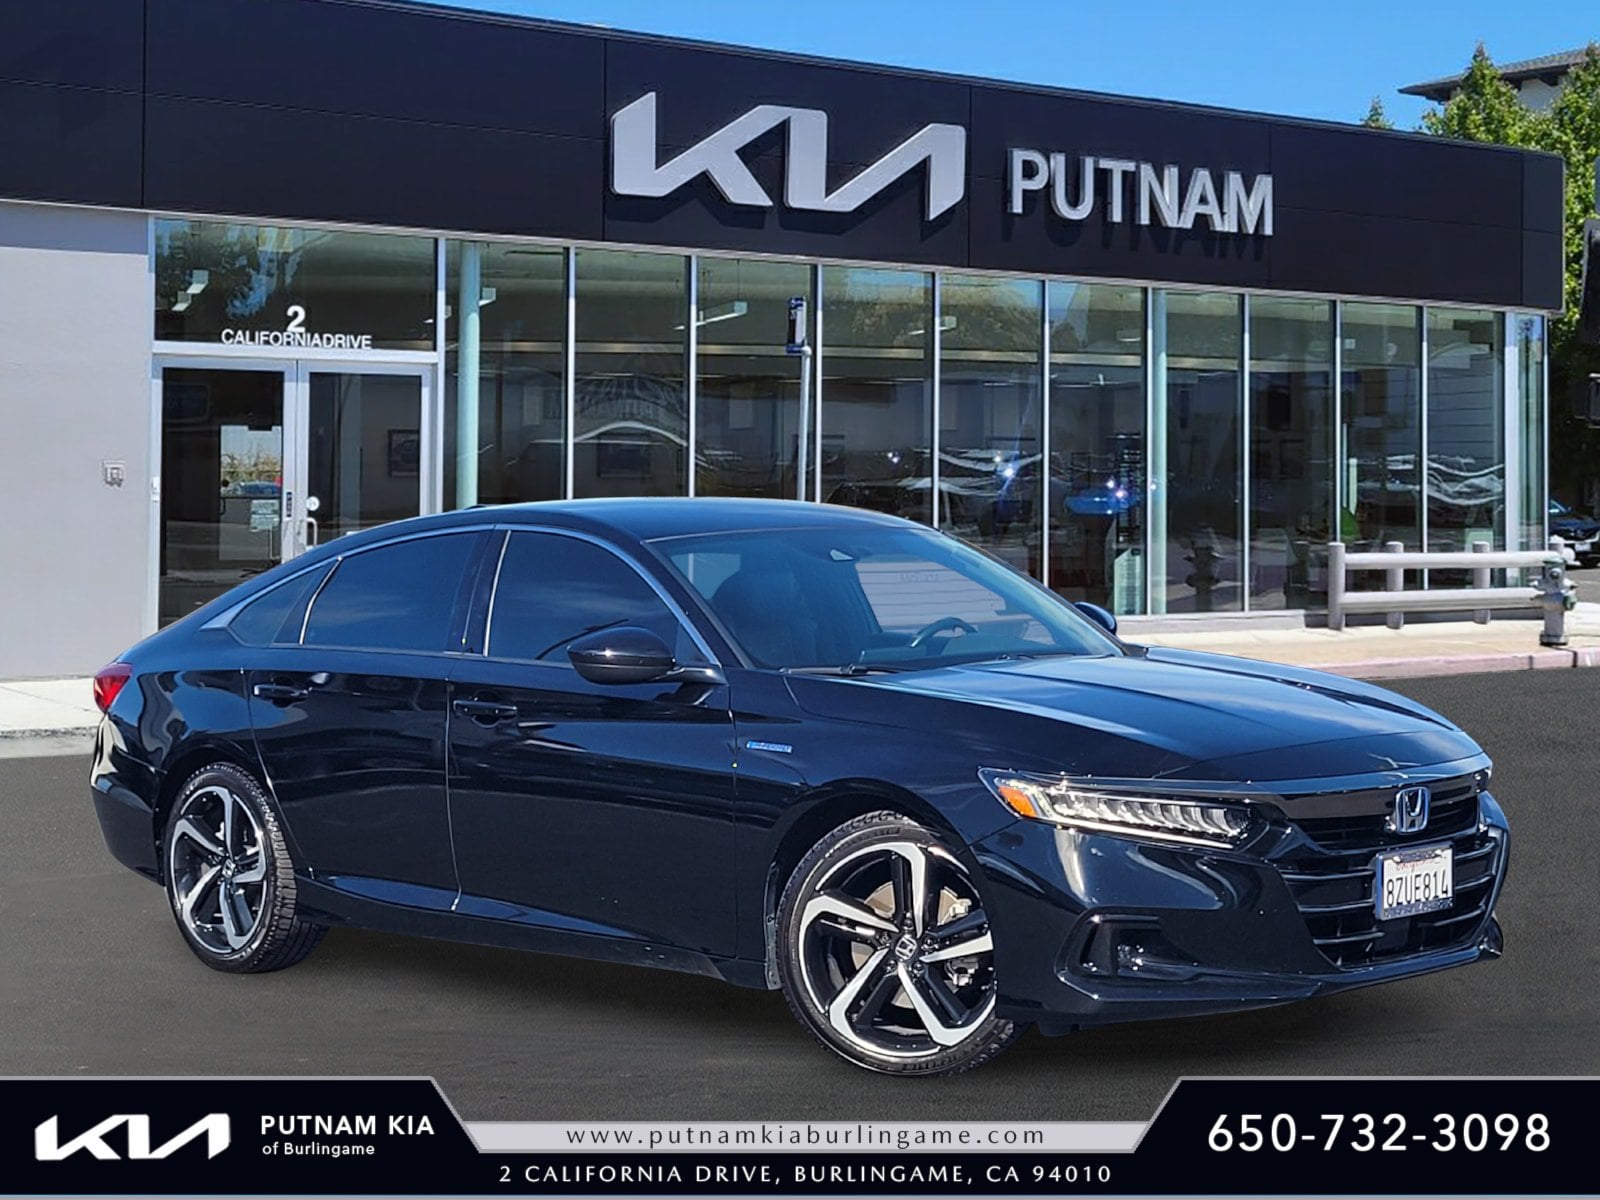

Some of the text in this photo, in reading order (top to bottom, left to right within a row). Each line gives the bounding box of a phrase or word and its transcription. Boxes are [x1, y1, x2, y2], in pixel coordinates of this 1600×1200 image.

[1008, 147, 1273, 236] PUTNAM
[286, 304, 307, 333] 2
[1386, 869, 1449, 907] 8ZUE814
